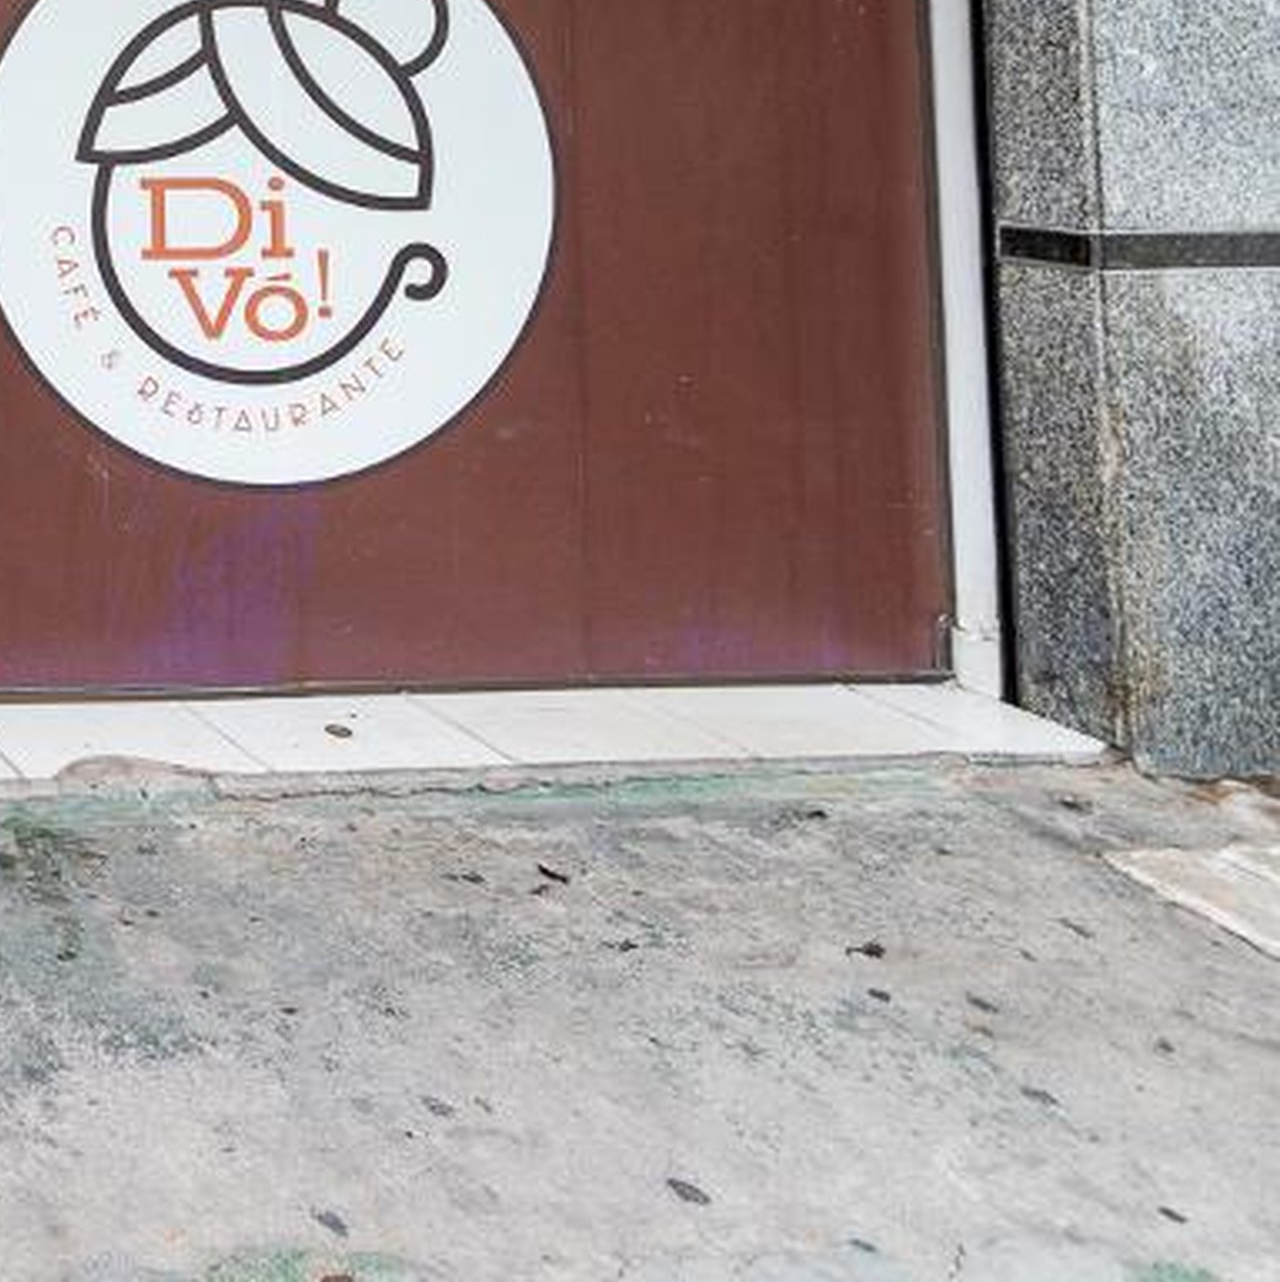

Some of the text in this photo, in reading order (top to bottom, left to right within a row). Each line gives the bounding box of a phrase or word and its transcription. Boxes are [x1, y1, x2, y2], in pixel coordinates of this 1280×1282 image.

[140, 176, 295, 260] Di
[50, 224, 101, 328] CAFÉ
[136, 336, 406, 433] RESTAURANTE
[167, 248, 333, 342] Vó!
